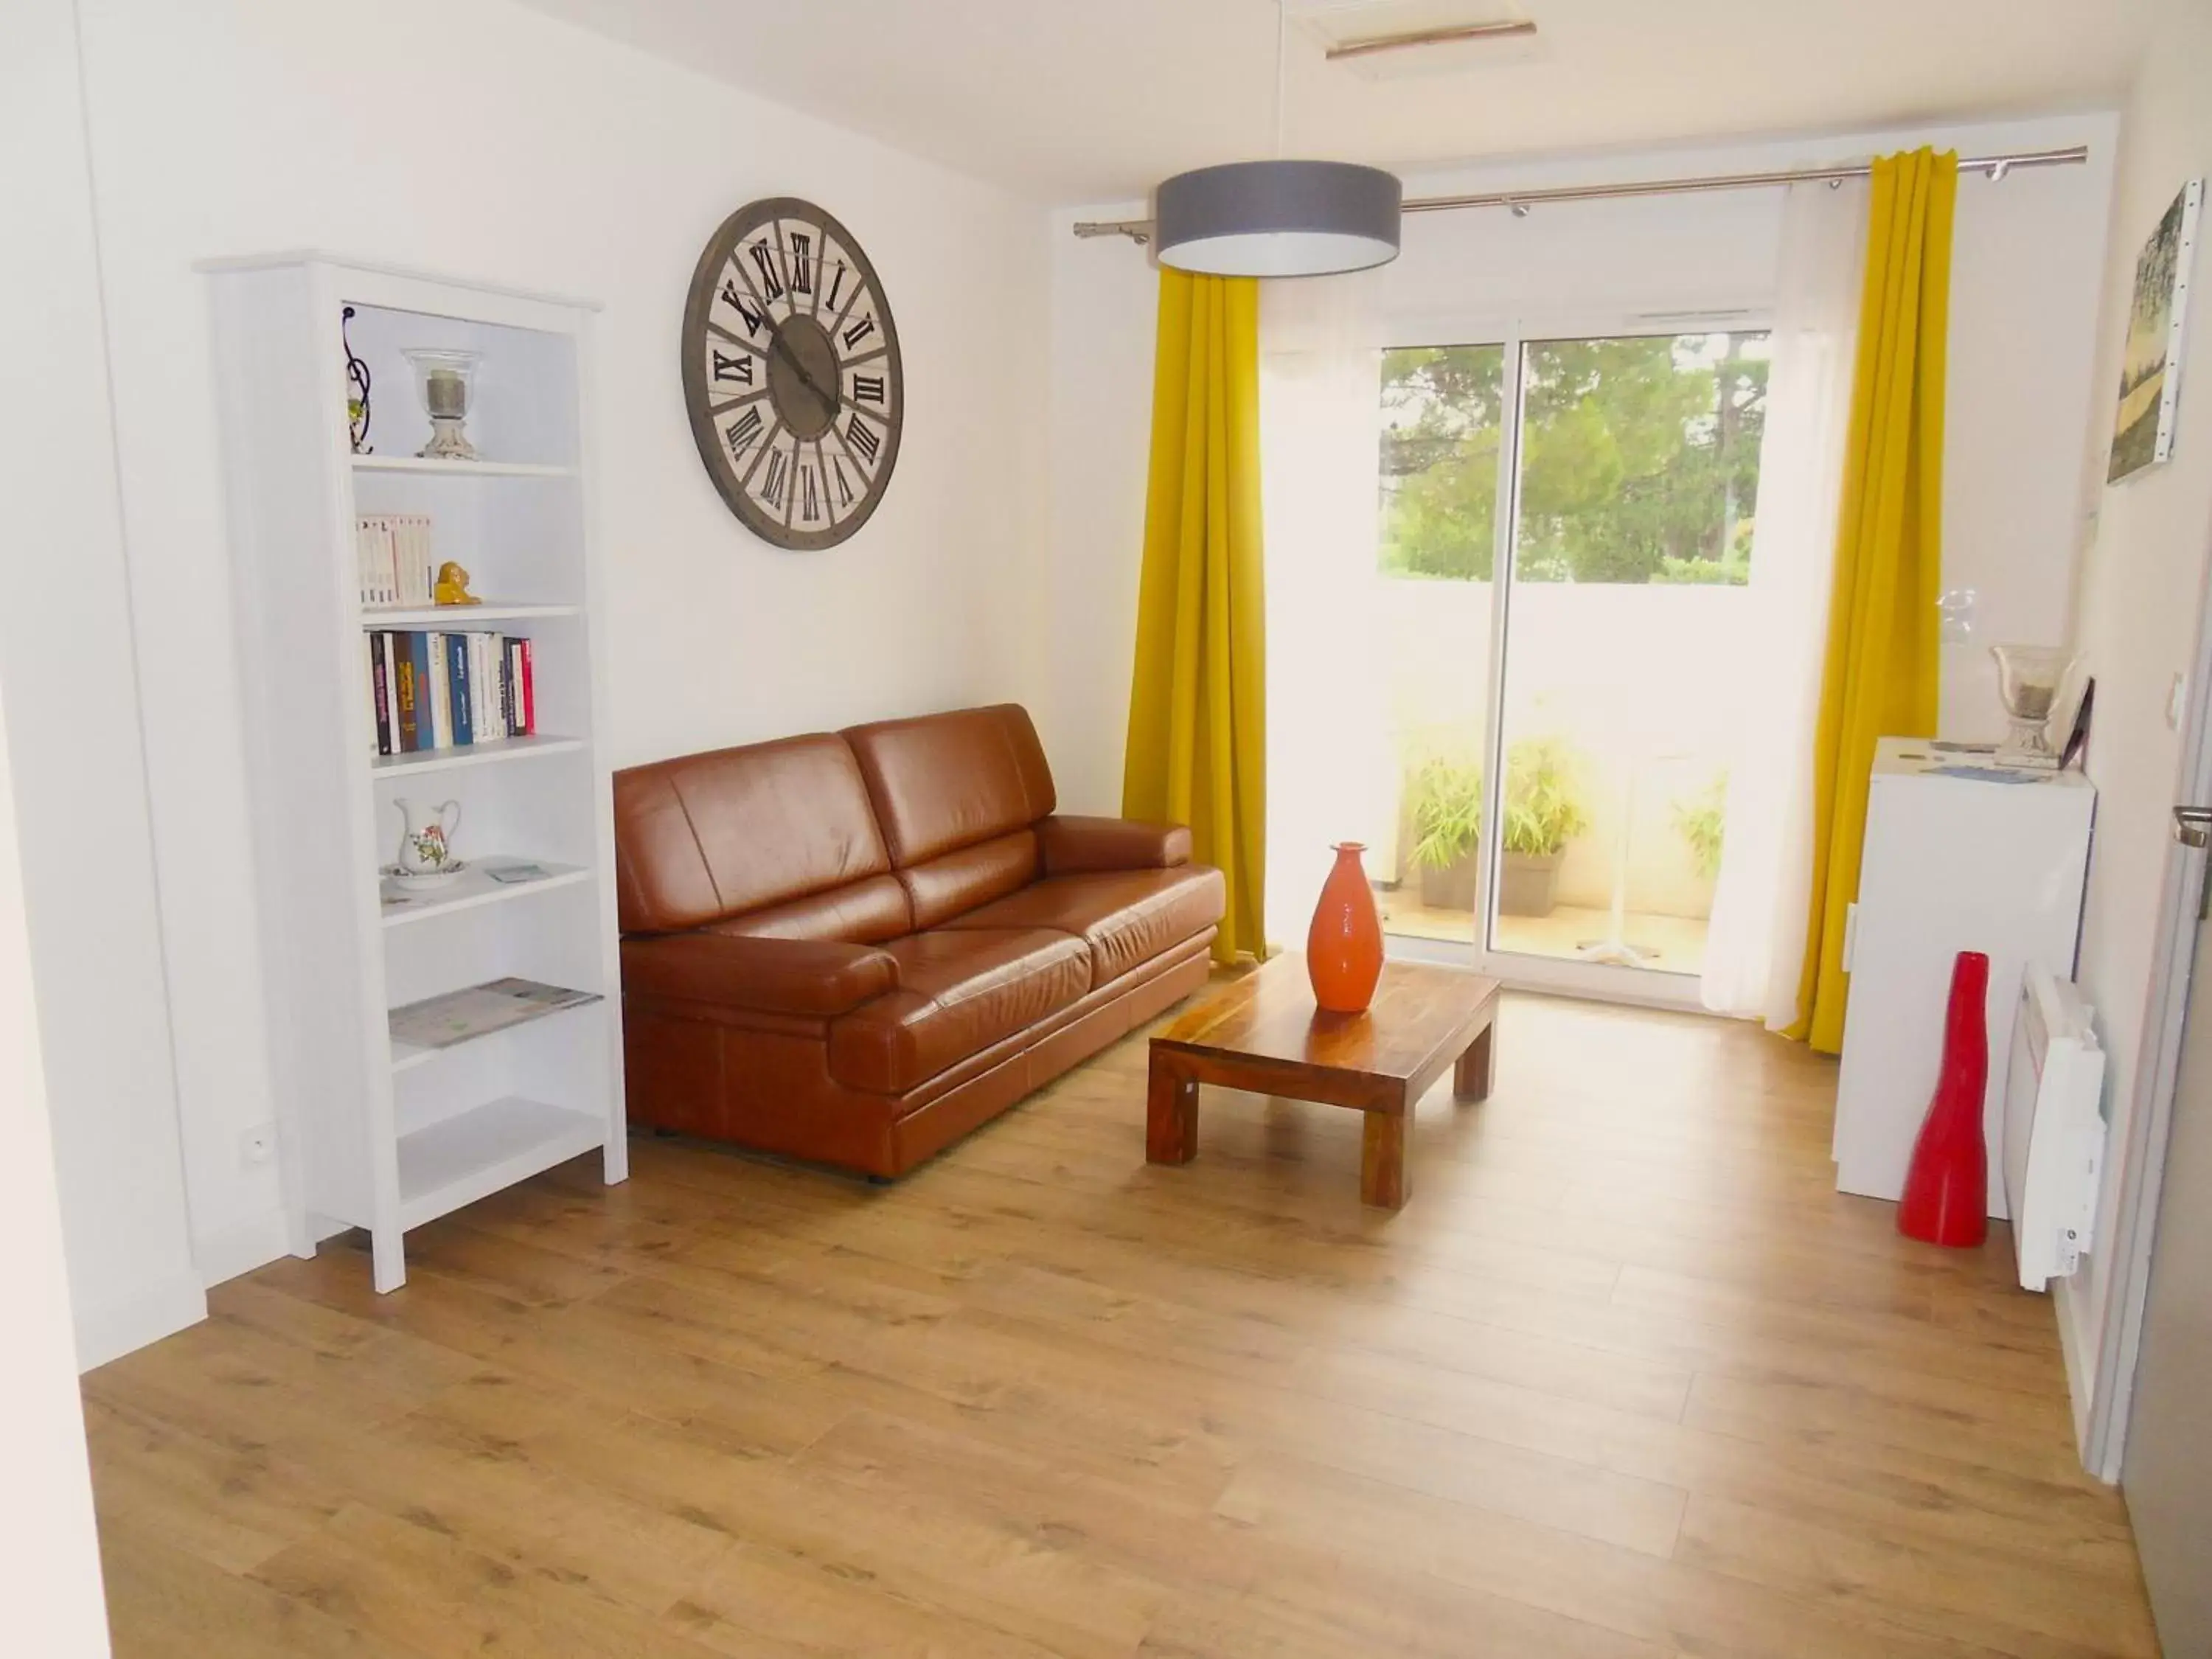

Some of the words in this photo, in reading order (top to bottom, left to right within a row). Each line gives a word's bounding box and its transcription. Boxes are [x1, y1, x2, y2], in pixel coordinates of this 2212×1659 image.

[749, 237, 784, 306] XI
[790, 232, 811, 295] XII
[825, 259, 847, 311] I
[721, 279, 766, 338] X
[843, 311, 876, 351] II
[713, 349, 752, 386] IX
[853, 373, 884, 405] III
[846, 413, 880, 466] IIII
[760, 446, 787, 512] VII
[800, 464, 819, 522] VI
[833, 454, 855, 508] V
